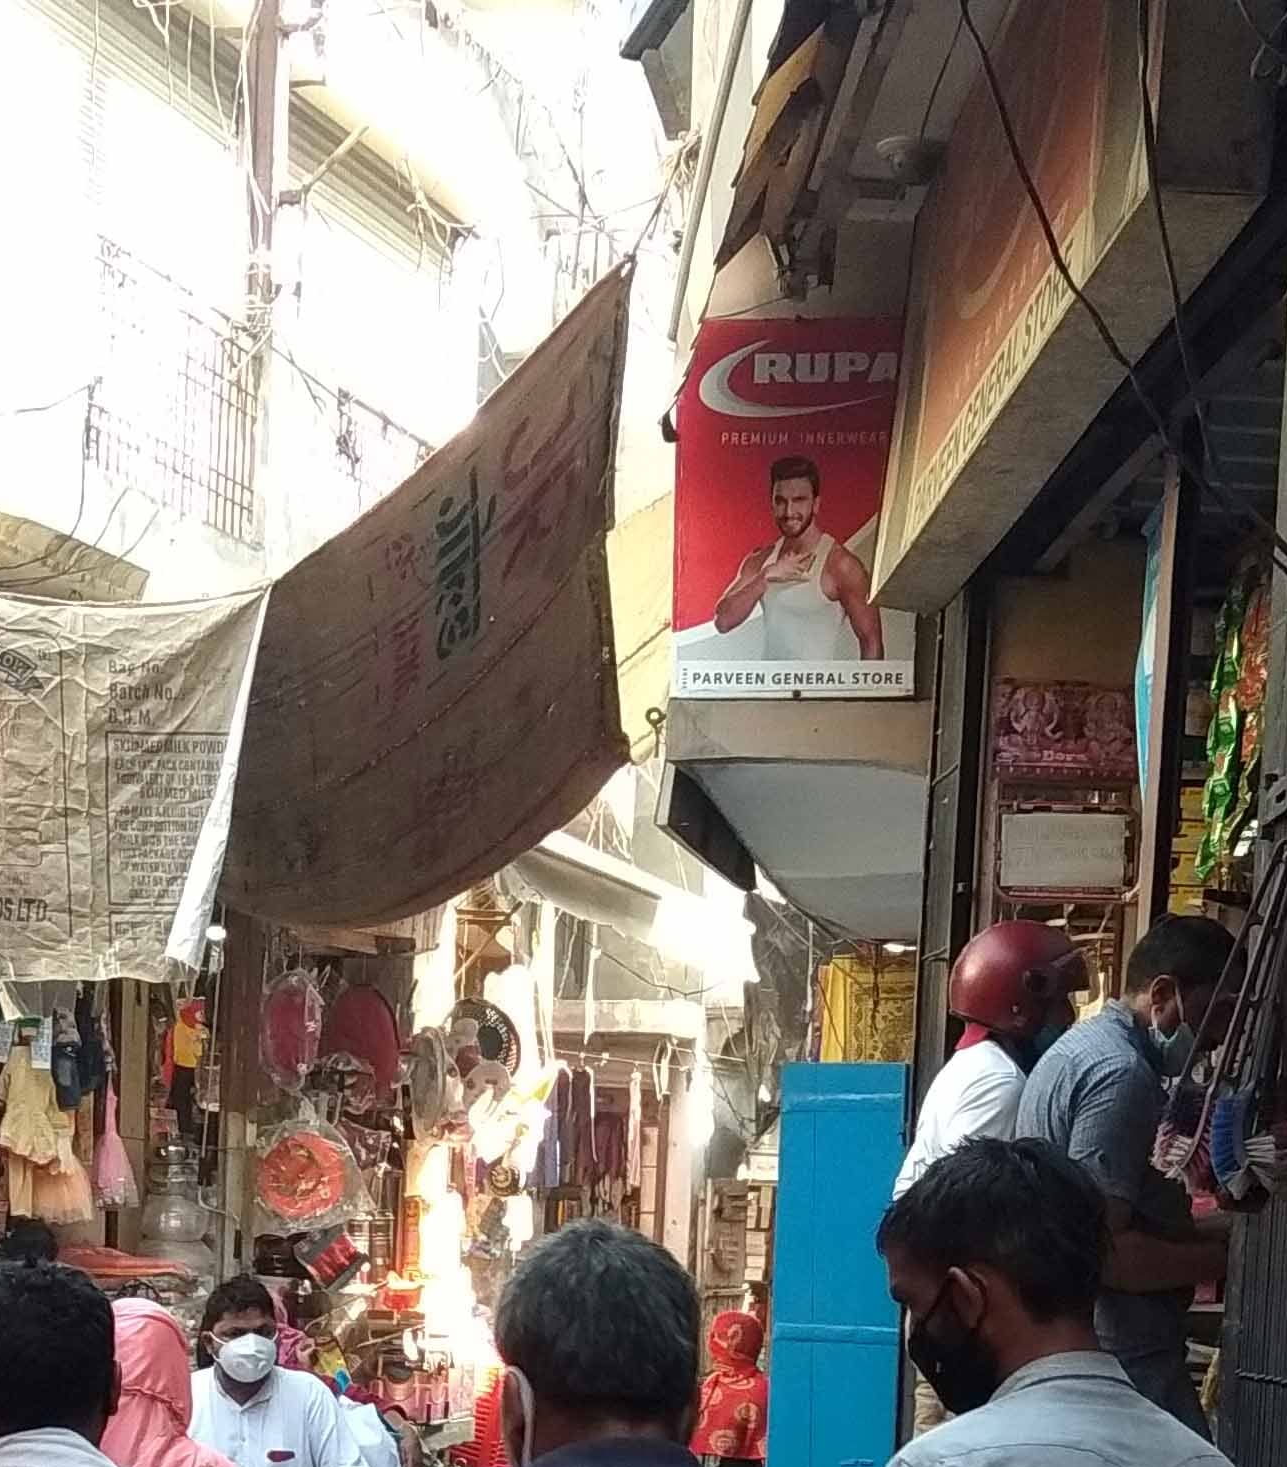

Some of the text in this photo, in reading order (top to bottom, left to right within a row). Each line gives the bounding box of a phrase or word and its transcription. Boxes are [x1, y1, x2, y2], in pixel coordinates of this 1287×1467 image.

[962, 329, 1019, 447] GENERAL
[1024, 237, 1074, 353] STORE
[753, 351, 901, 385] RUPA
[721, 431, 789, 447] PREMIUM
[692, 670, 904, 688] PARVEEN GENERAL STORE
[109, 681, 150, 701] Batch
[163, 738, 192, 754] MILK
[192, 739, 227, 755] POWD
[16, 896, 53, 923] LTD.
